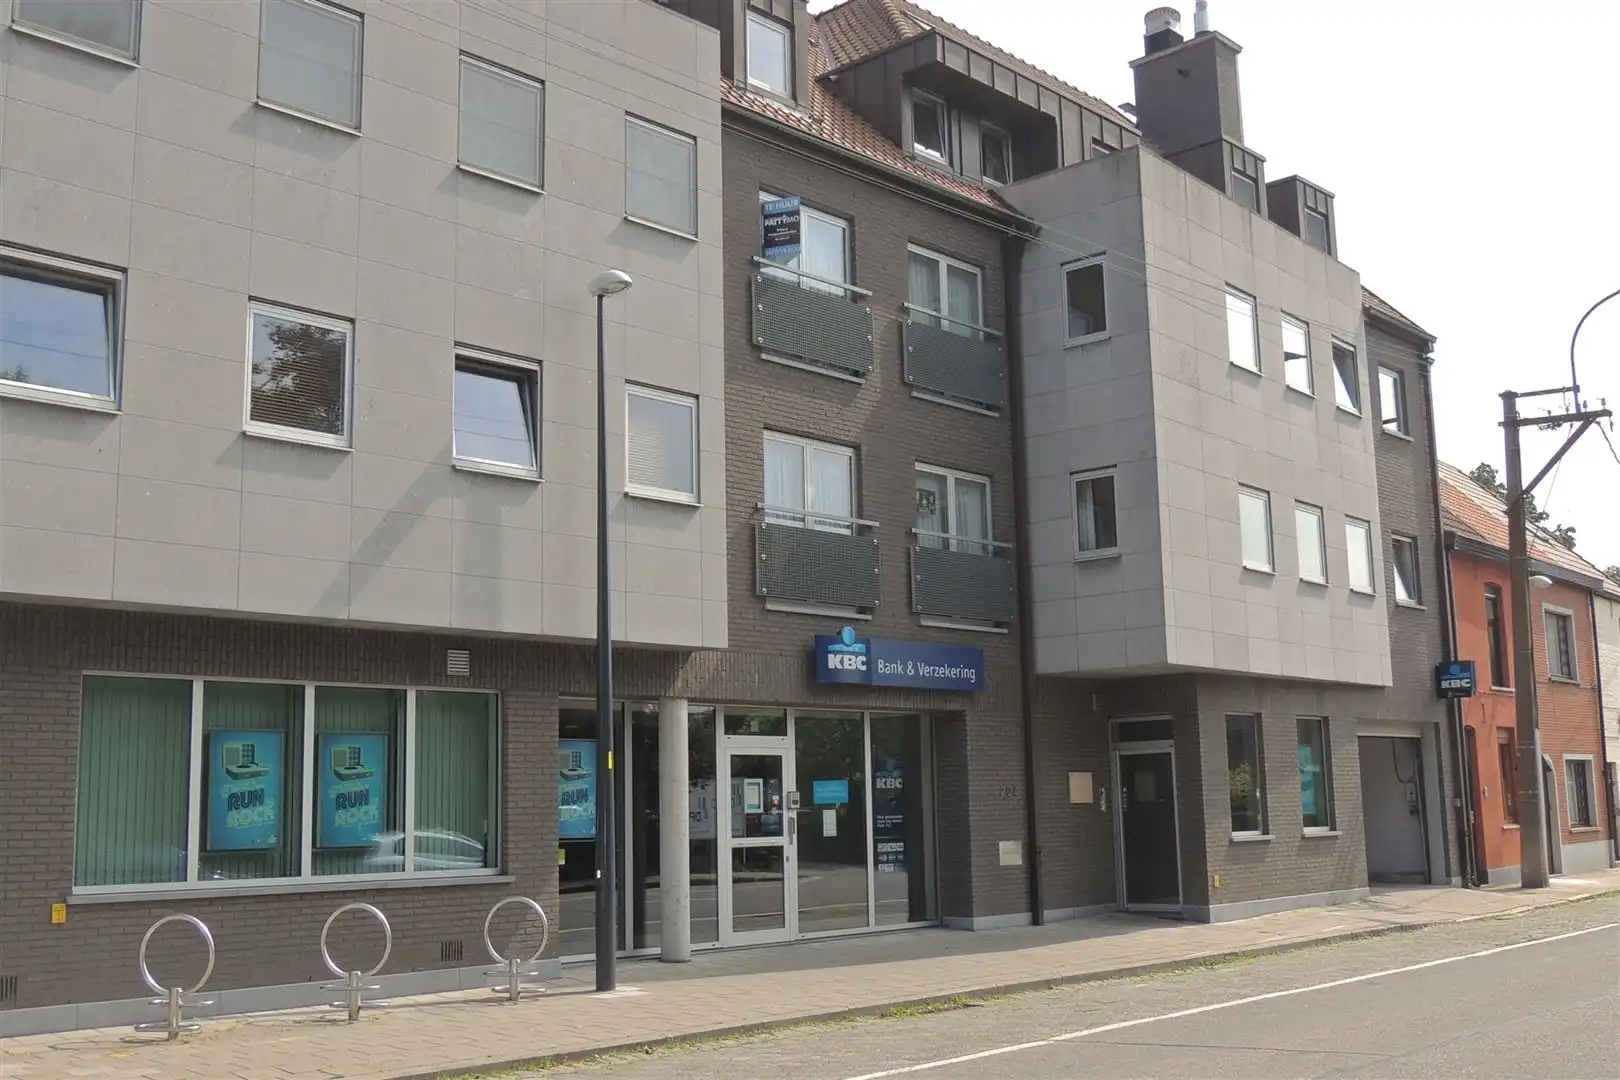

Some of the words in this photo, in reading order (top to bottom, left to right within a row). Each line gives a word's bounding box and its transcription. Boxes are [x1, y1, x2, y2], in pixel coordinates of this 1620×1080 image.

[775, 200, 799, 209] HUUR
[828, 653, 867, 671] KBC
[877, 659, 904, 675] Bank
[906, 662, 915, 676] &
[917, 662, 976, 683] Verzekering
[1441, 679, 1471, 689] KBC
[876, 777, 903, 789] KBC
[227, 788, 265, 812] RUN
[335, 788, 370, 811] RUN
[561, 787, 589, 806] RUN
